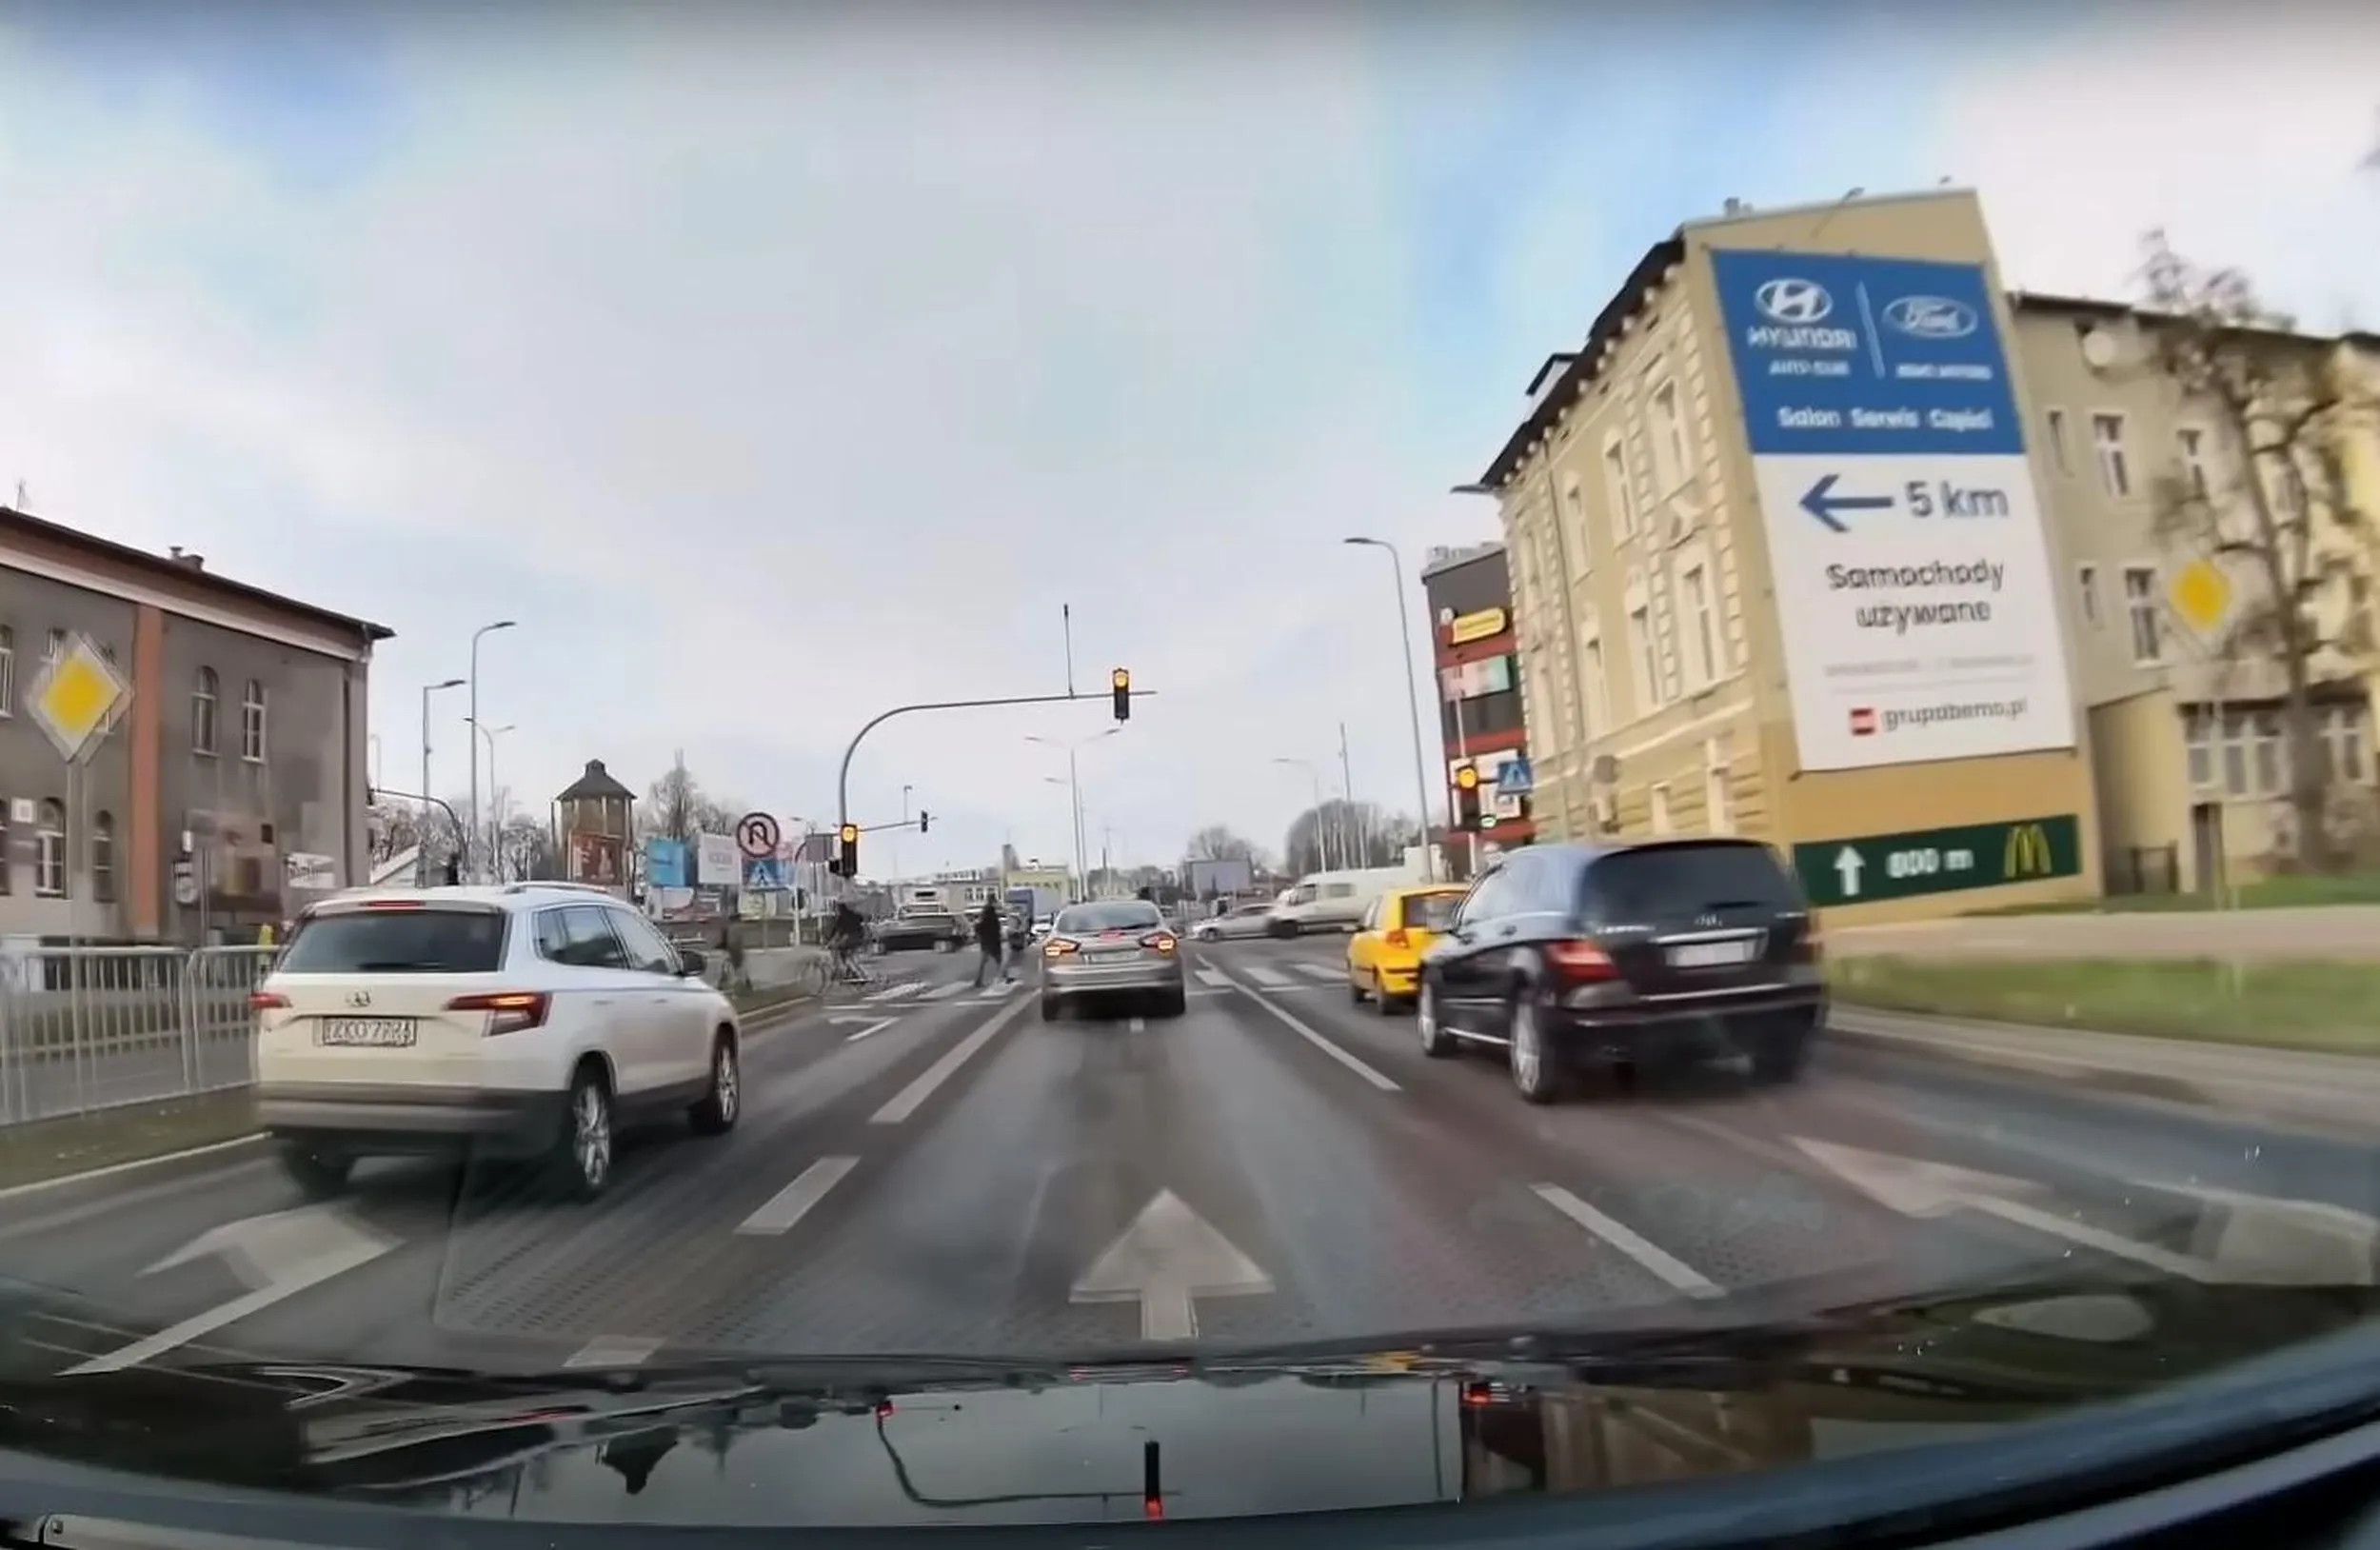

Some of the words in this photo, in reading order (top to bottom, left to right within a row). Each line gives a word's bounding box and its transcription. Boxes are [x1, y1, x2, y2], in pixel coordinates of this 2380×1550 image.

[1778, 407, 1841, 427] Salon
[1906, 480, 1933, 517] 5
[1941, 480, 2009, 517] km
[1826, 558, 2004, 592] Samochody
